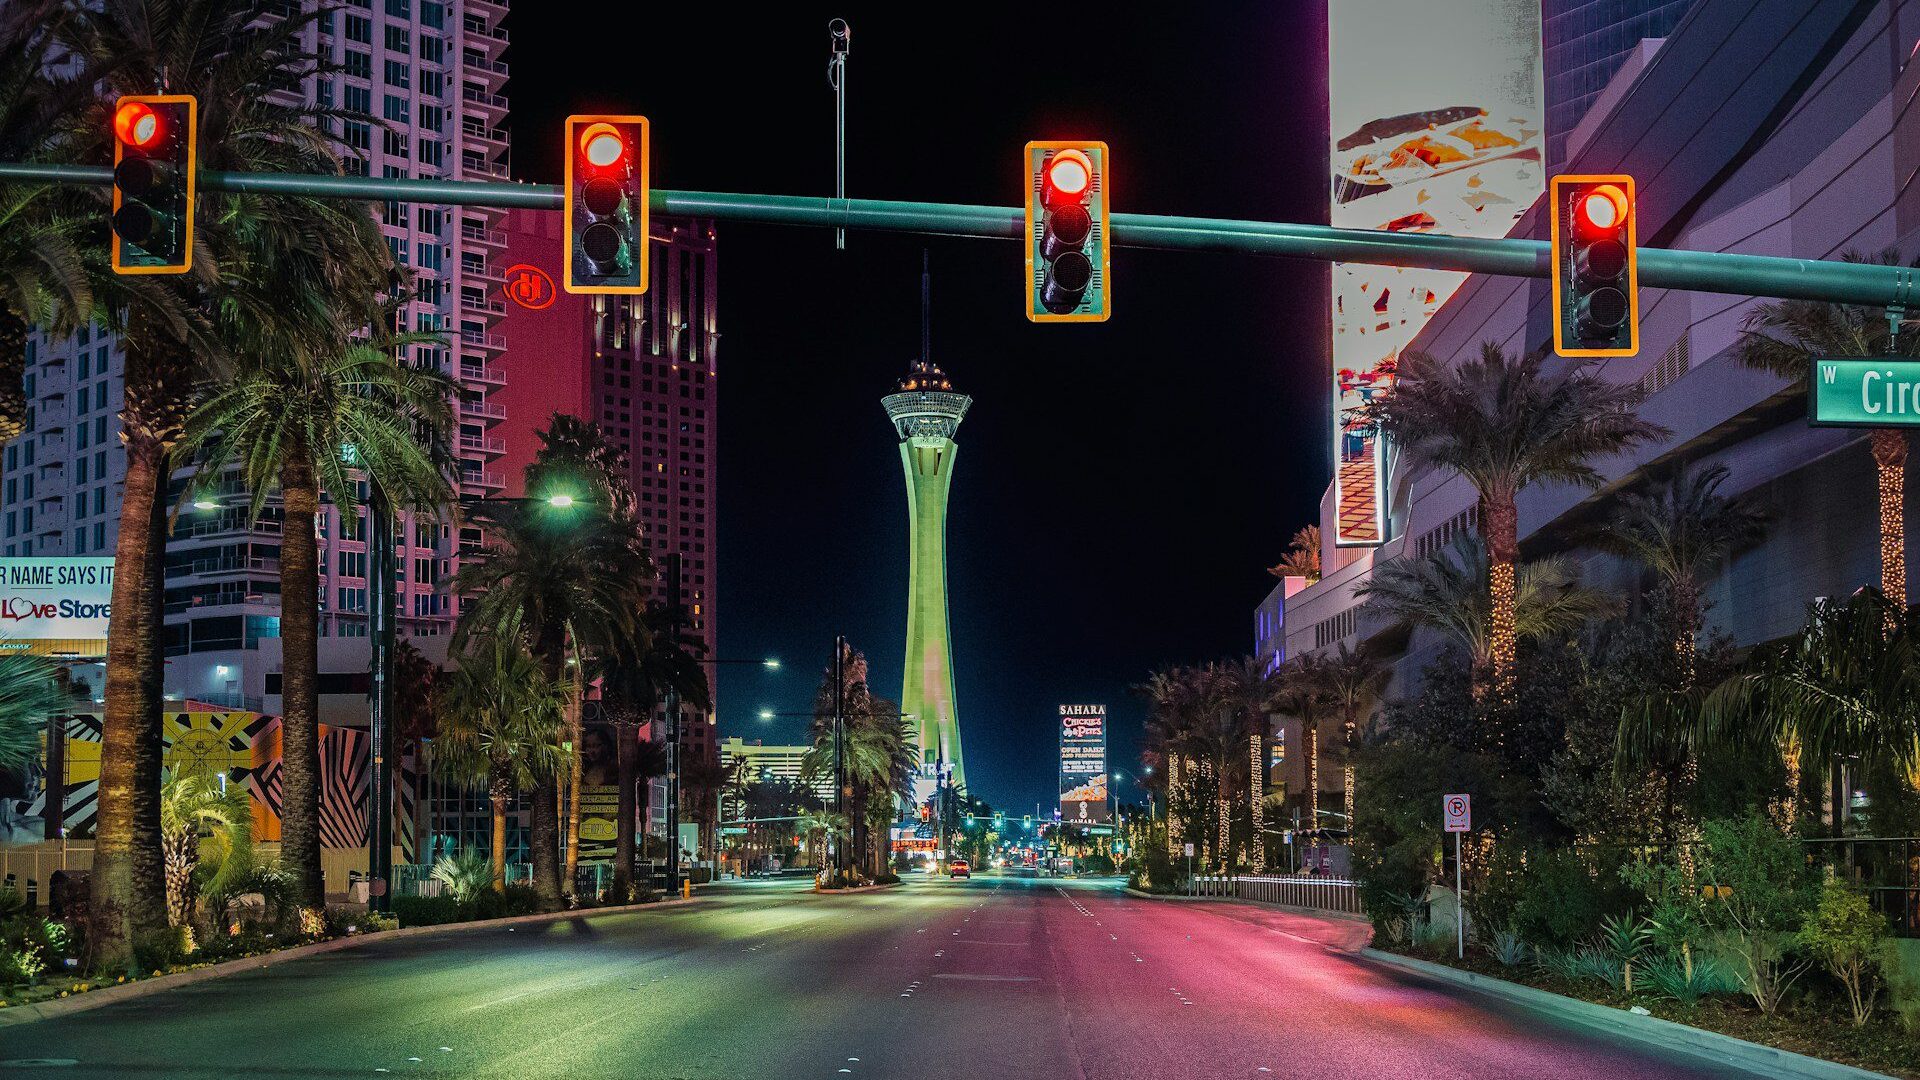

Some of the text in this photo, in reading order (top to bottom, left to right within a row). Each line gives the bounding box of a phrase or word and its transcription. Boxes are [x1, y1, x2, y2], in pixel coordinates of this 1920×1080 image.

[1823, 366, 1837, 384] W
[11, 566, 54, 585] NAME
[58, 566, 96, 585] SAYS
[100, 566, 115, 585] IT
[1060, 706, 1105, 715] SAHARA
